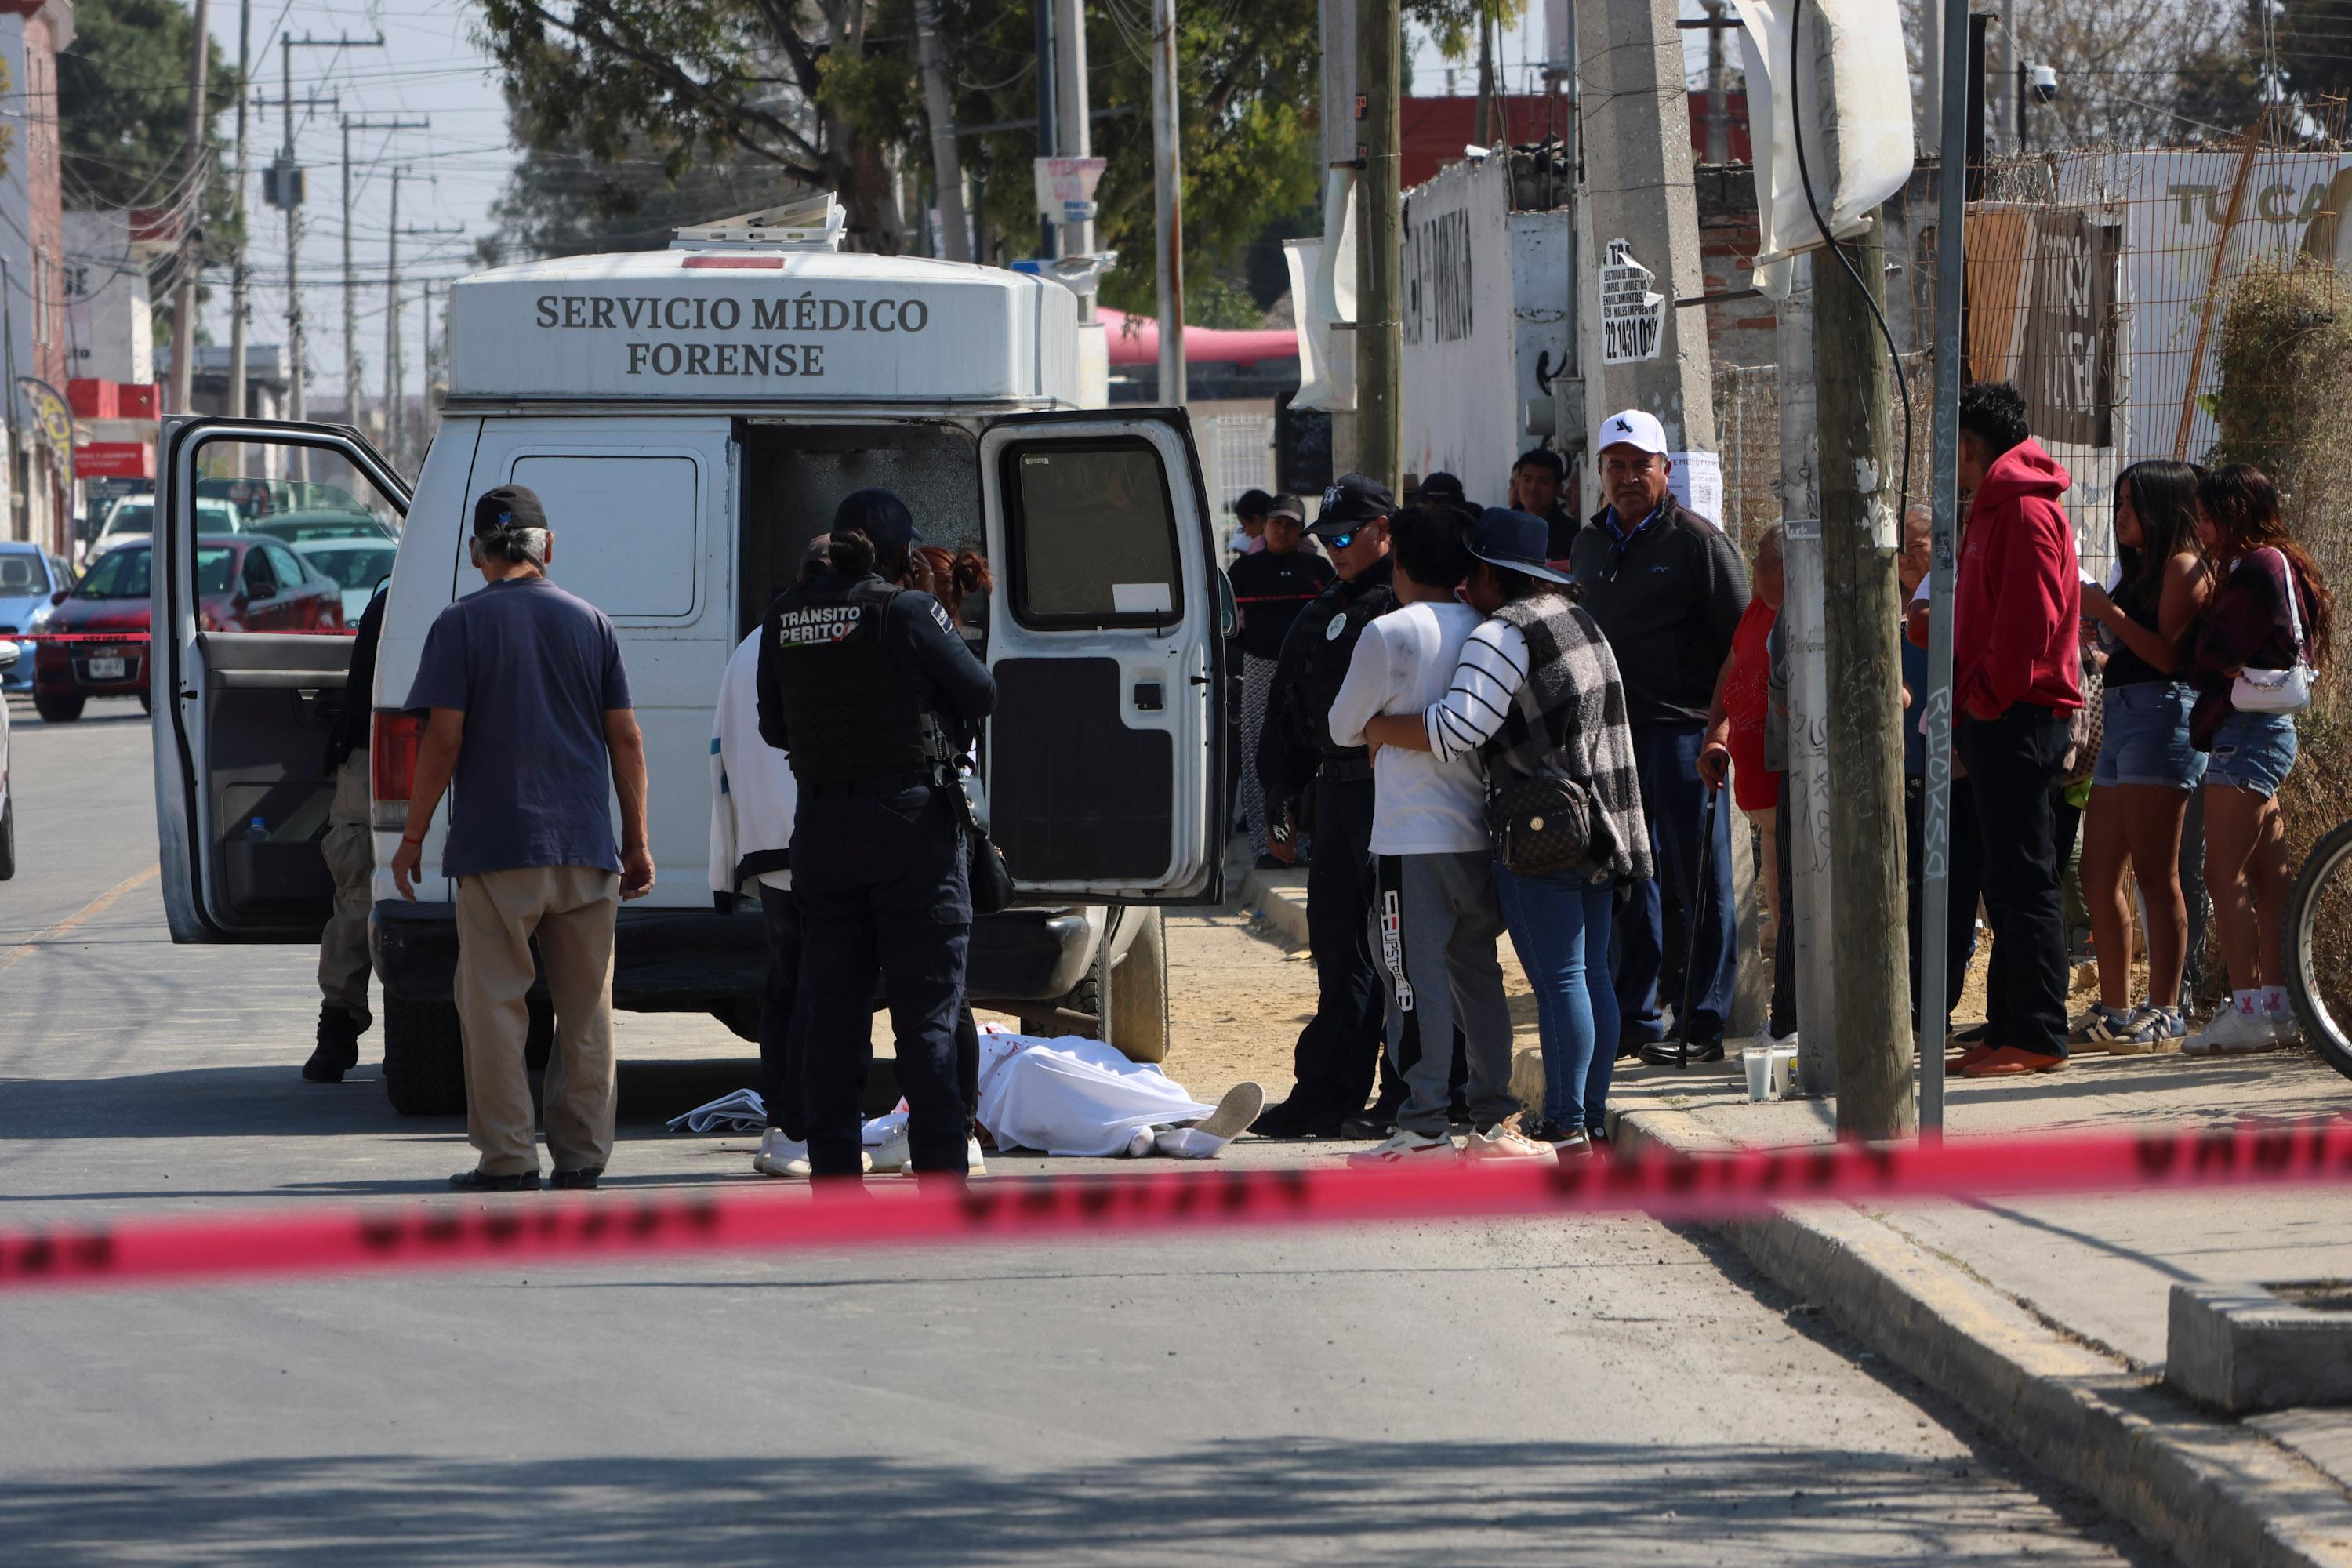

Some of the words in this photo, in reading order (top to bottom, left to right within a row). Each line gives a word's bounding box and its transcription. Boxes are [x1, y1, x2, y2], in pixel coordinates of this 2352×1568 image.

[1604, 270, 1621, 281] LECTURA
[1622, 269, 1627, 278] DE
[1604, 281, 1620, 293] LIMPIAS
[1624, 279, 1647, 291] AMULETOS
[536, 295, 741, 330] SERVICIO
[751, 290, 928, 332] MÉDICO
[1614, 306, 1628, 318] MALES
[1628, 303, 1659, 316] IMPUESTOS
[626, 343, 824, 376] FORENSE
[780, 606, 861, 628] TRÁNSITO
